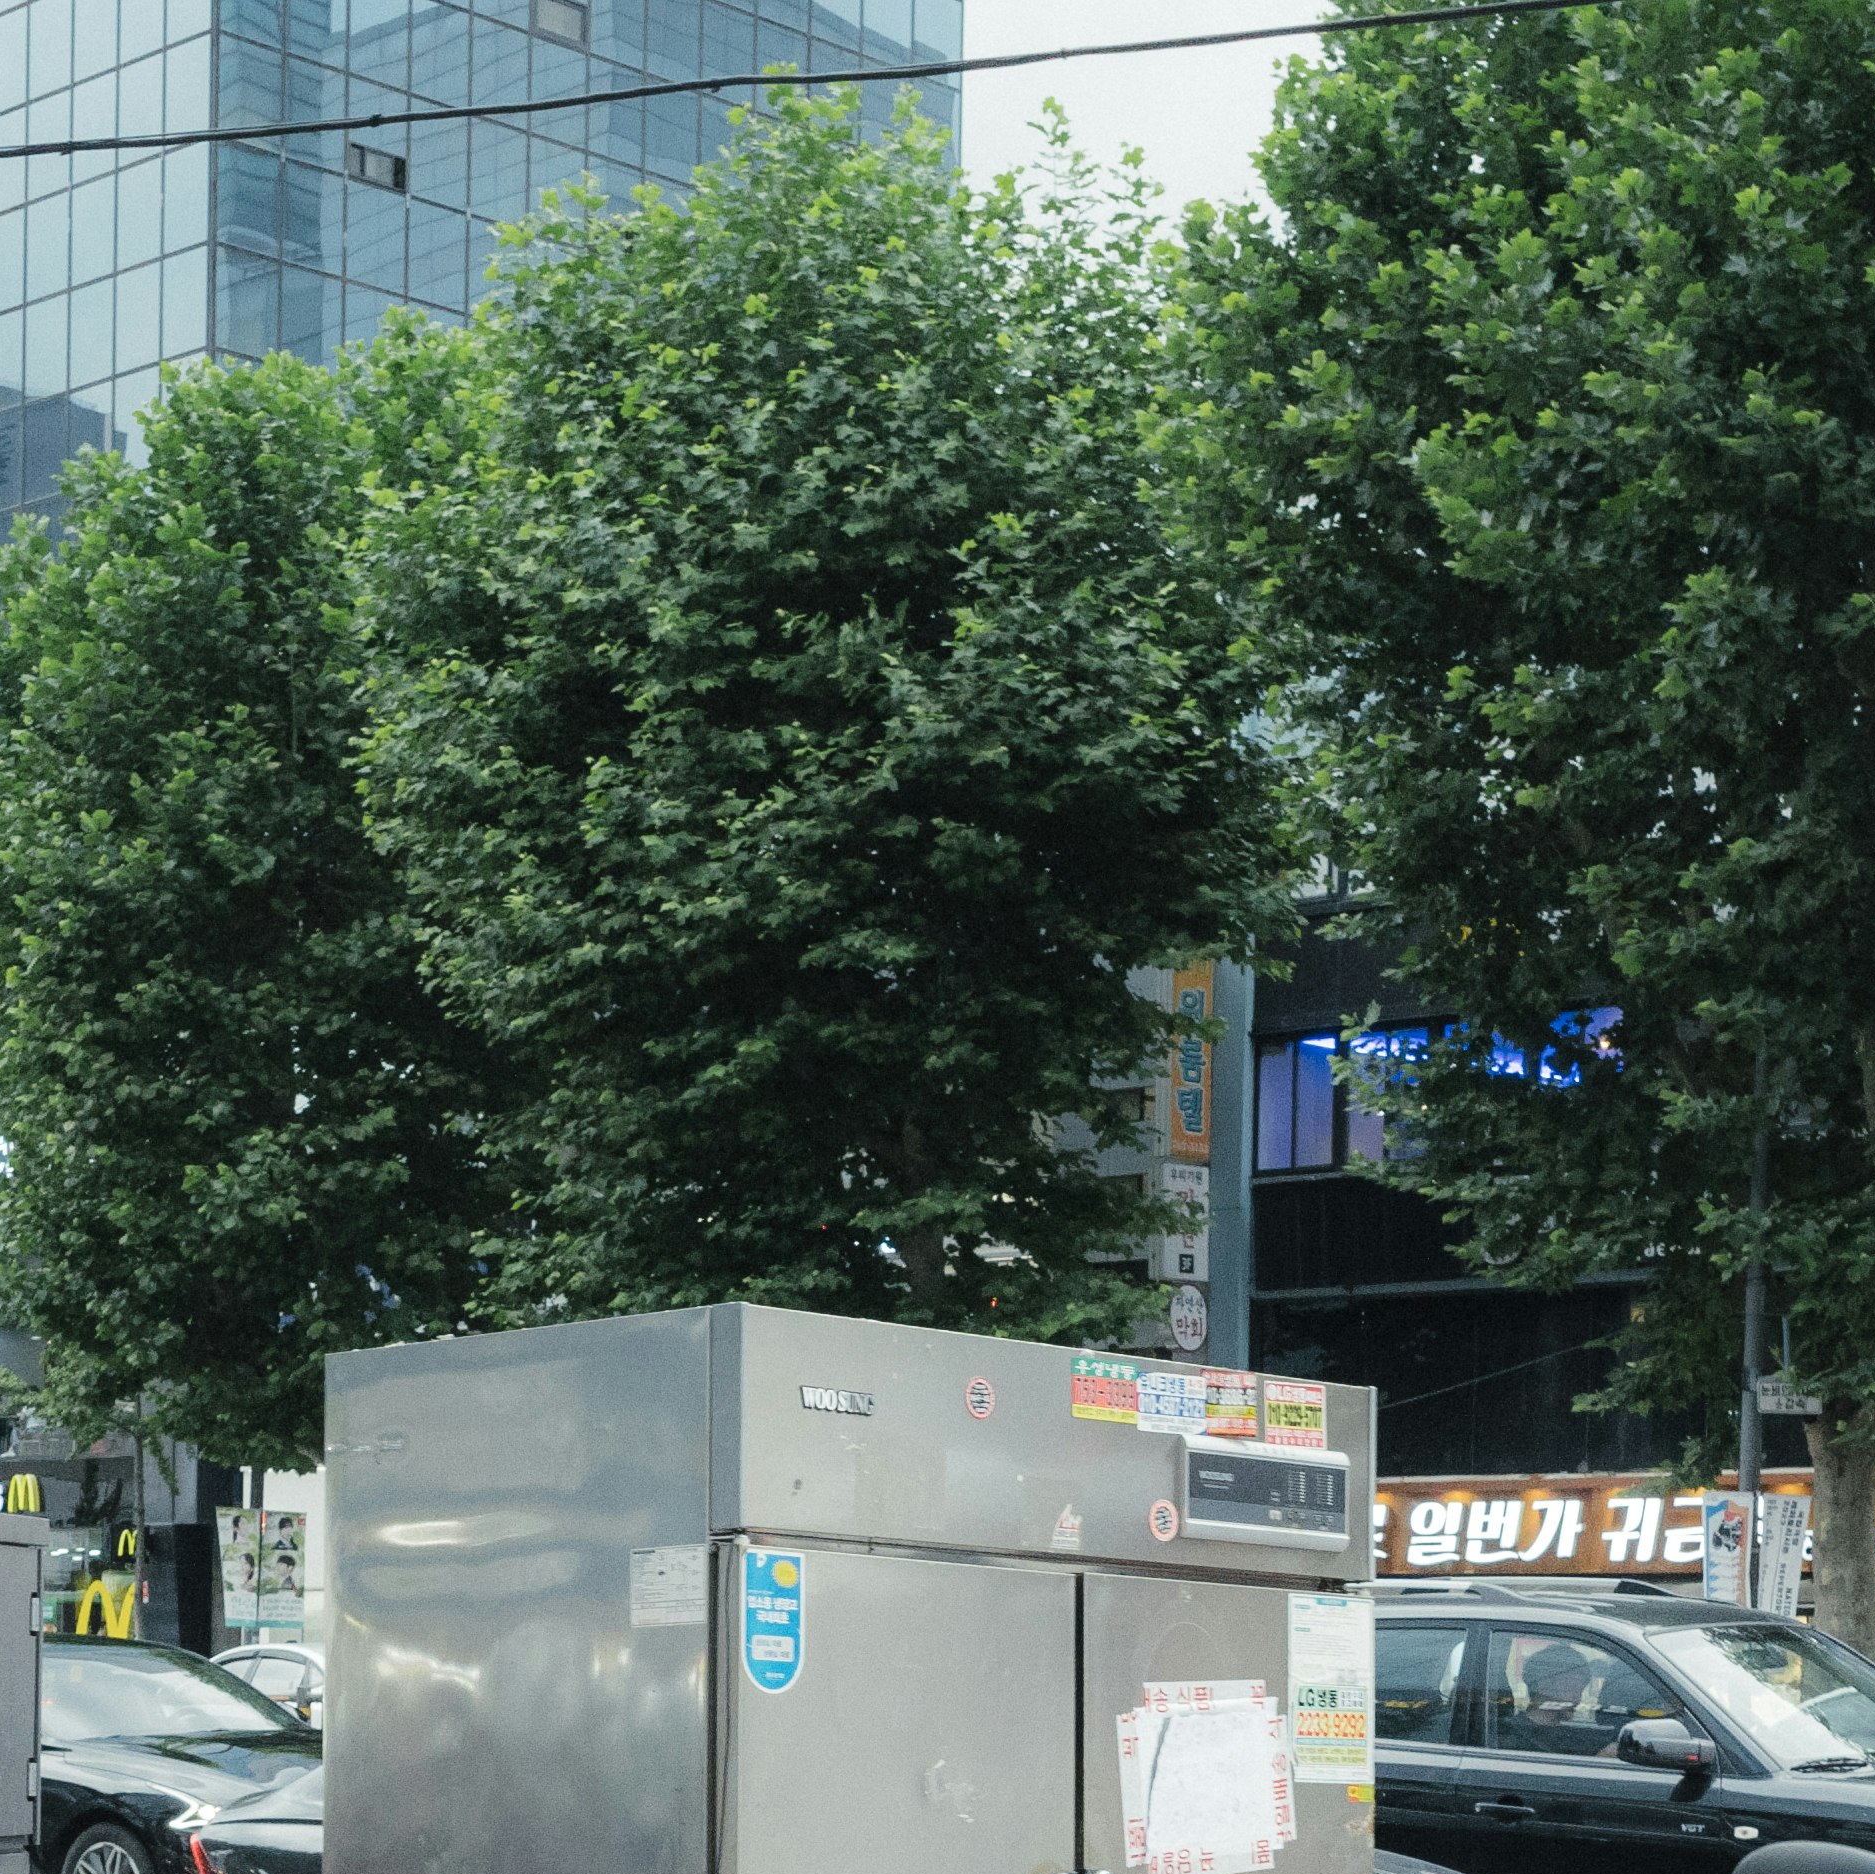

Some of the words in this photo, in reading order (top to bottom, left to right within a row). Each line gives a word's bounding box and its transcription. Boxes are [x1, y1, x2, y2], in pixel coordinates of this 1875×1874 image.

[1175, 1316, 1204, 1340] 막회
[1407, 1499, 1585, 1565] 일번가
[1601, 1497, 1706, 1562] 귀금
[1298, 1688, 1315, 1707] LG
[1317, 1689, 1337, 1708] 냉동
